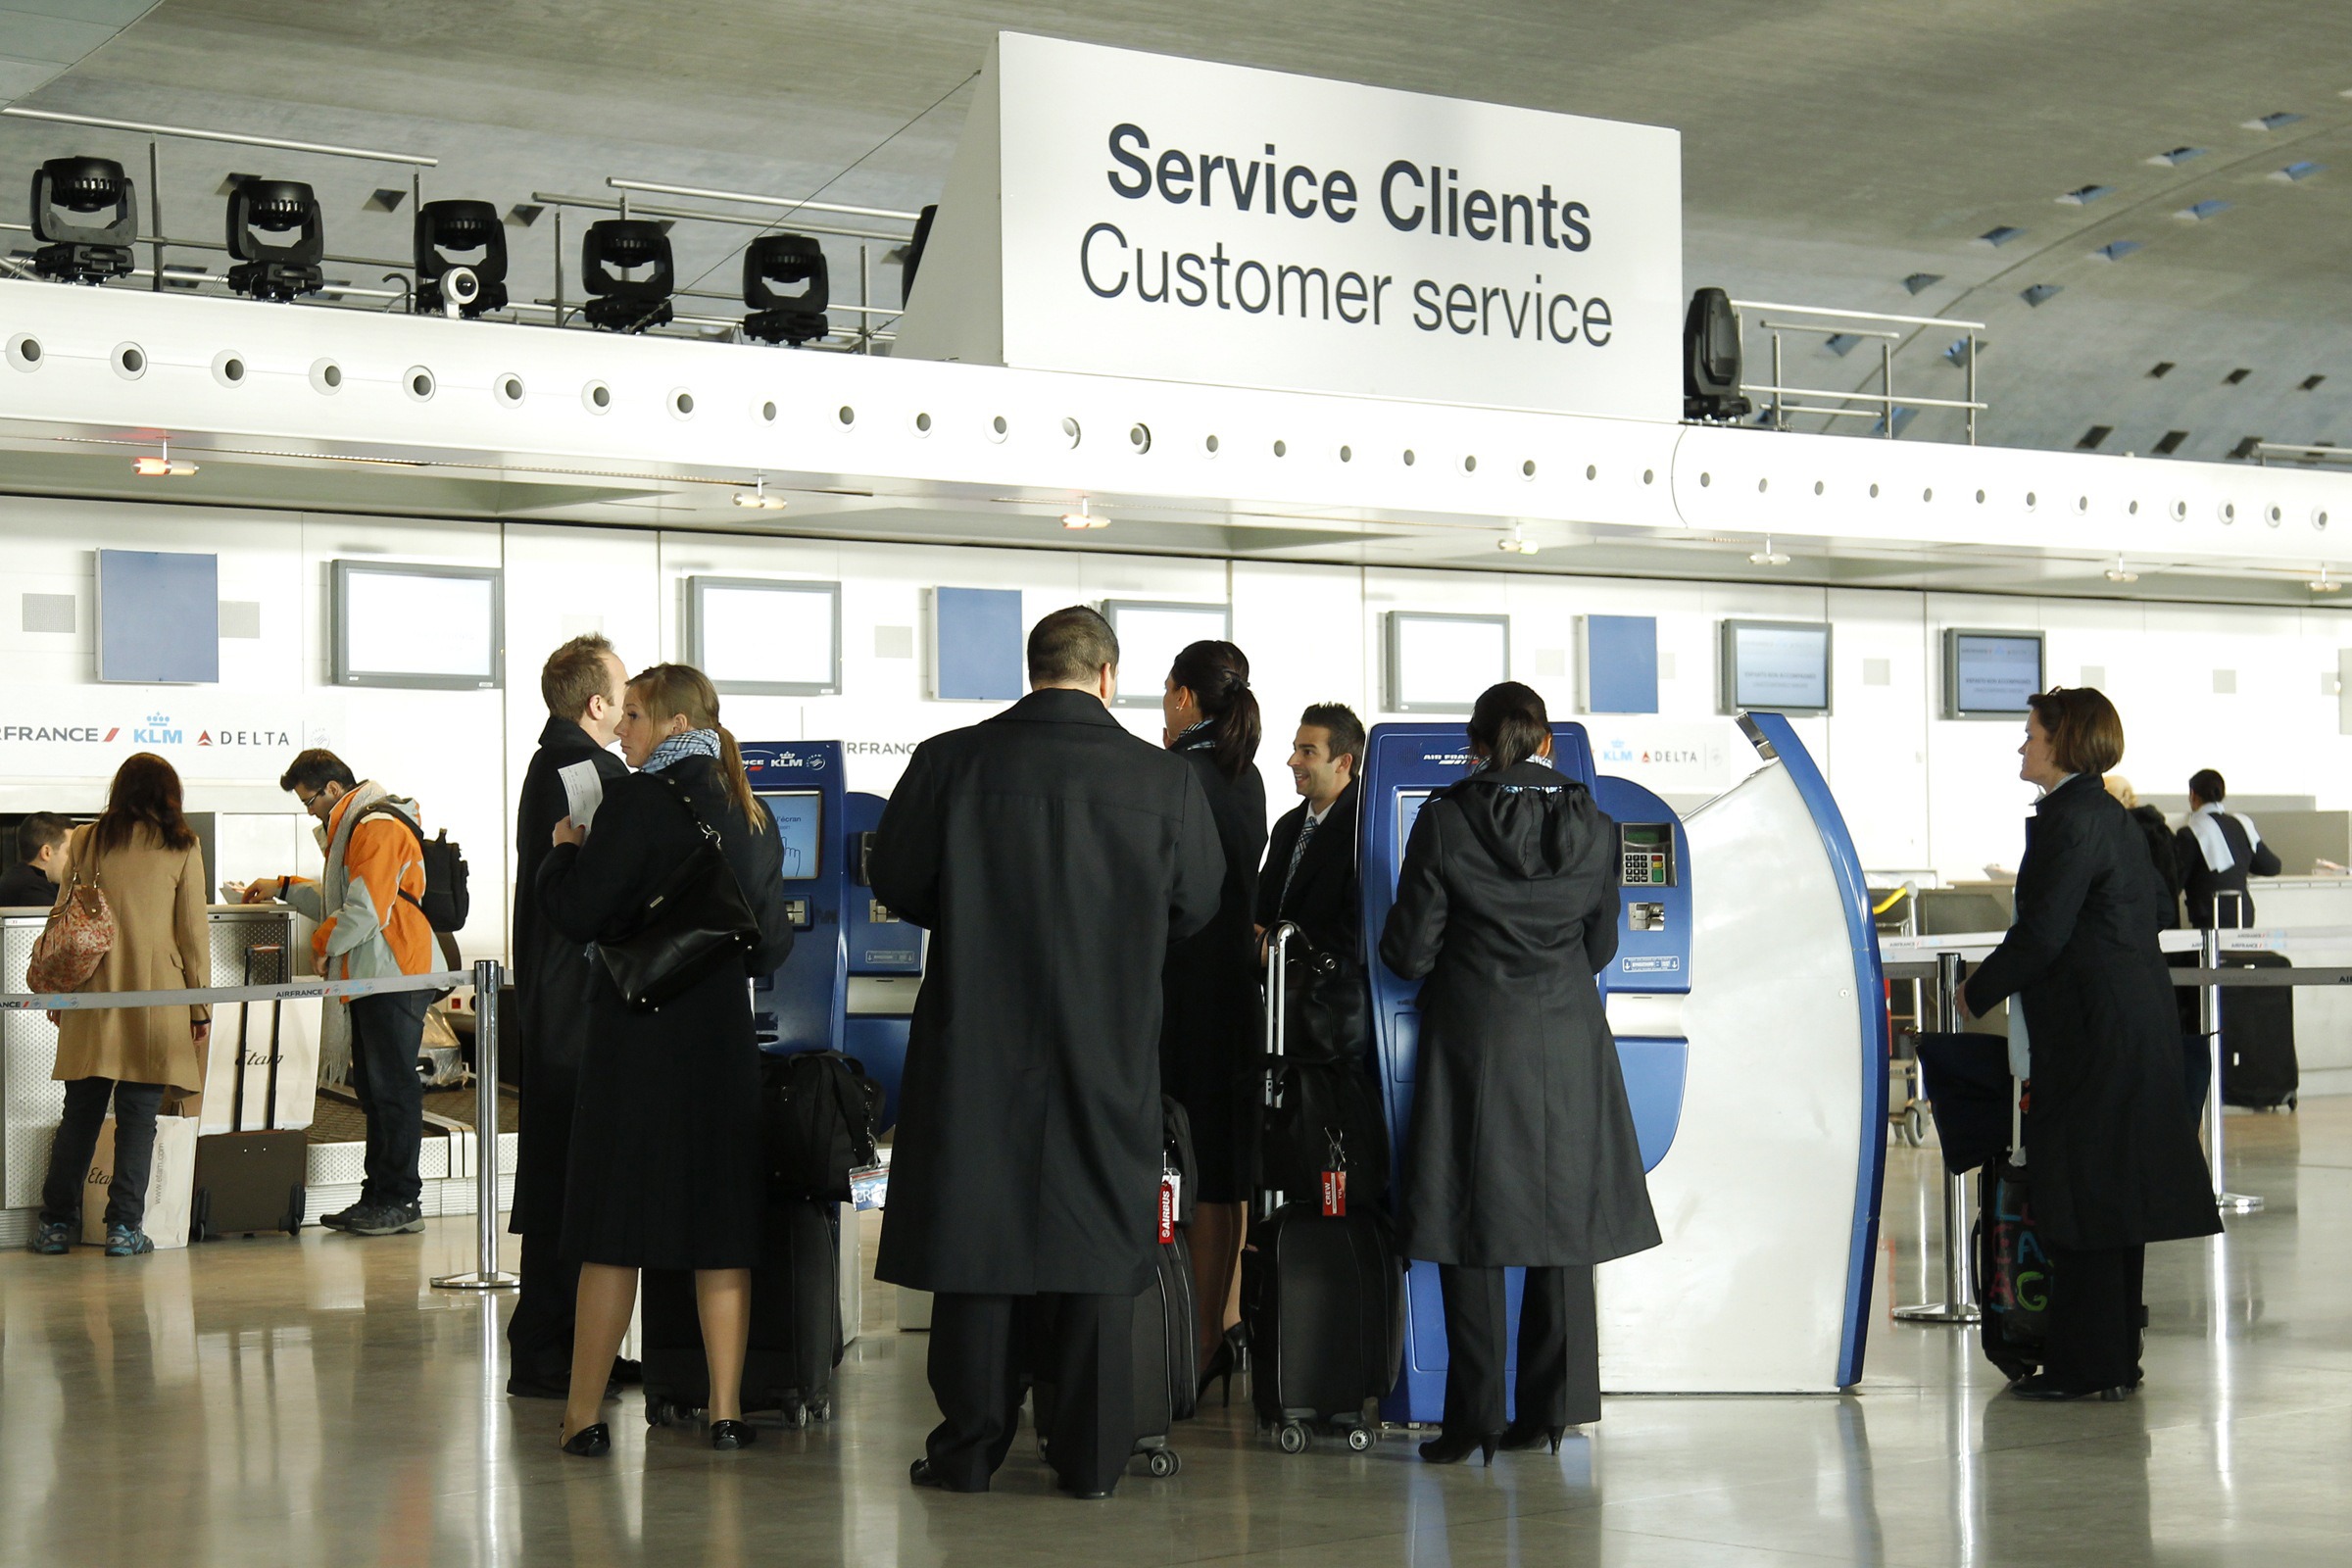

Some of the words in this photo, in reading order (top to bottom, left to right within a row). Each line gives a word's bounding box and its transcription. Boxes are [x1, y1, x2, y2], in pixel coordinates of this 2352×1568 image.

[1107, 122, 1357, 223] Service
[1380, 160, 1592, 252] Clients
[1080, 222, 1392, 326] Customer
[1412, 274, 1613, 347] service
[0, 726, 99, 743] FRANCE
[133, 728, 183, 744] KLM
[220, 730, 290, 746] DELTA
[770, 759, 804, 767] KLM
[1603, 751, 1633, 761] KLM
[1655, 751, 1697, 762] DELTA
[275, 988, 323, 998] AIRFRANCE
[88, 1166, 112, 1185] Eta
[155, 1142, 165, 1204] www.etam.com
[1161, 1190, 1170, 1230] AIRBUS
